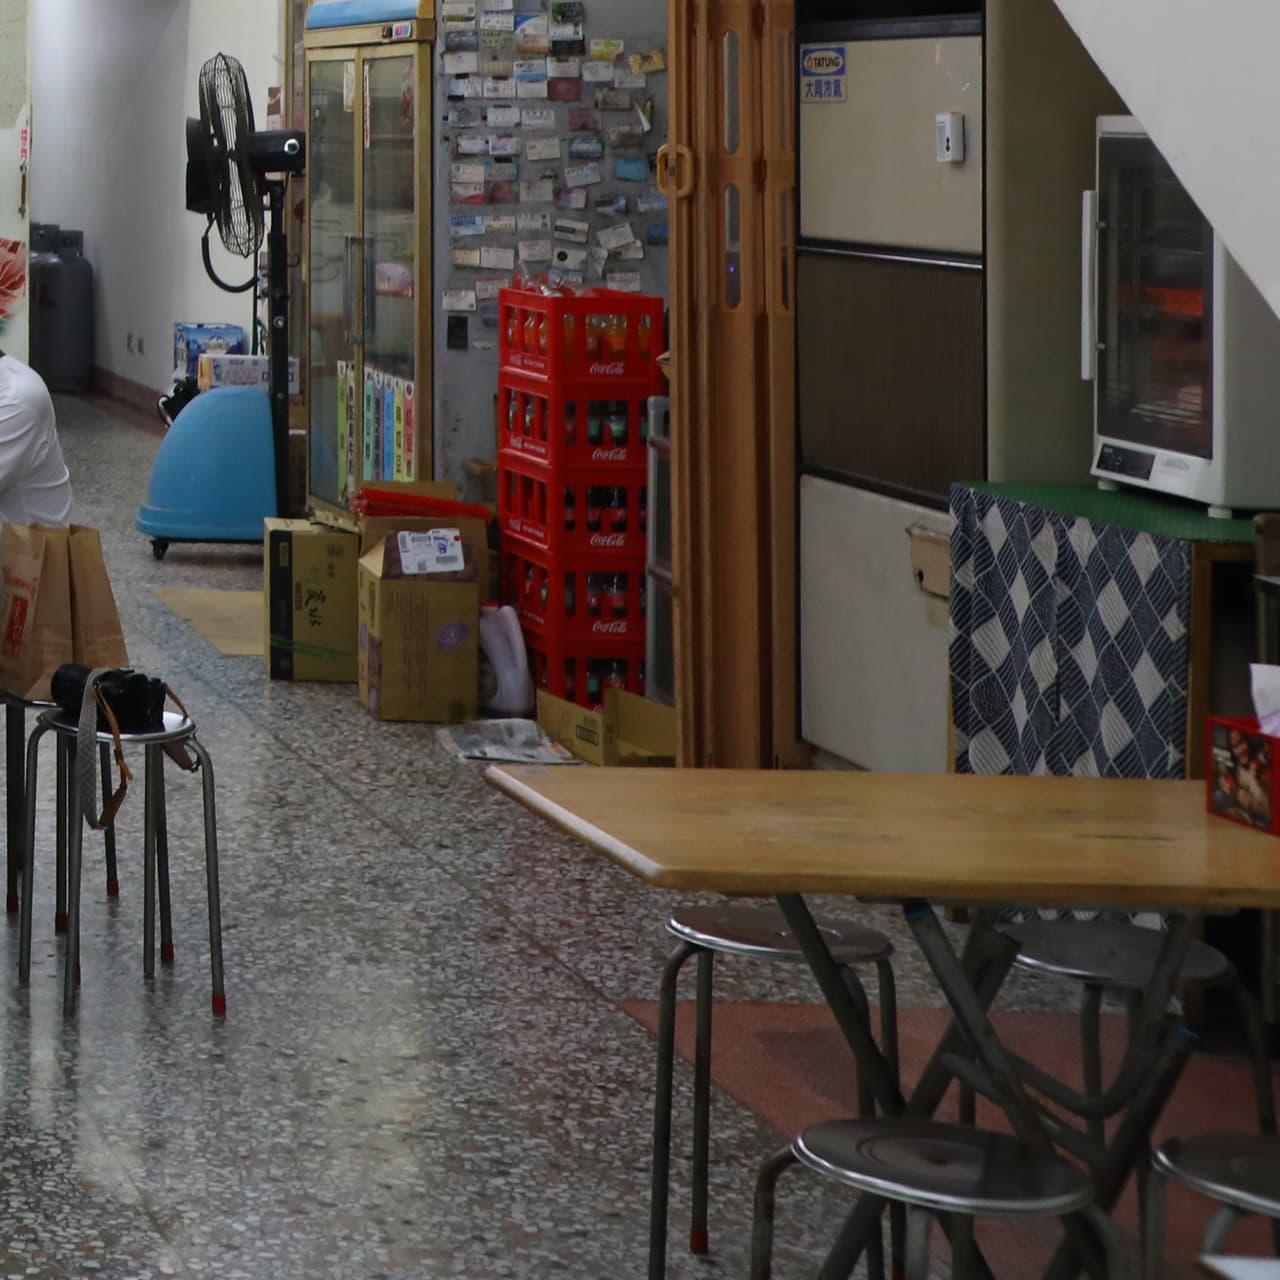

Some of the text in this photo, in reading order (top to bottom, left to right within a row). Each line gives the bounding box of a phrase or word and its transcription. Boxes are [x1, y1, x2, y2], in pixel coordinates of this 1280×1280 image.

[814, 56, 840, 68] TATUNG
[590, 363, 625, 375] Coca-Cola
[592, 448, 627, 461] Coca-Cola
[591, 535, 625, 547] Coca-Cola
[592, 620, 628, 633] Coca-Cola
